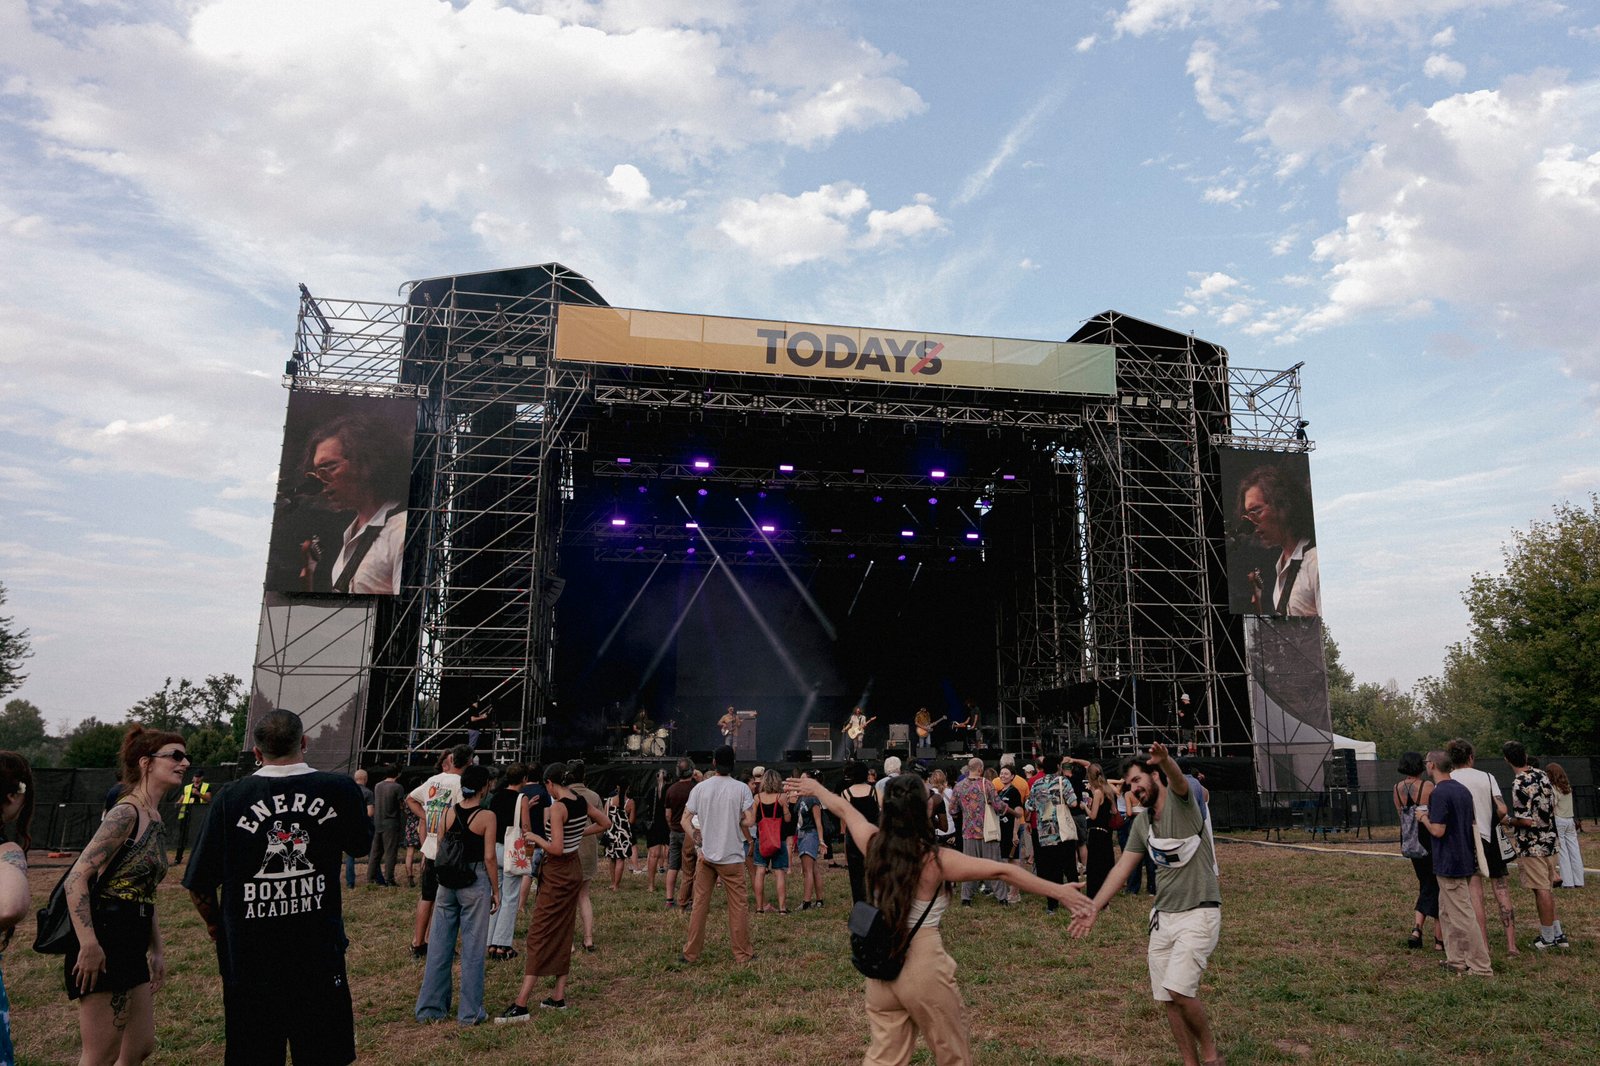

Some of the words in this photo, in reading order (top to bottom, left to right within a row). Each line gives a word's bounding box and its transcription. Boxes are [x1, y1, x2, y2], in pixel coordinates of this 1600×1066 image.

[236, 793, 338, 834] ENERGY
[243, 874, 326, 902] BOXING
[245, 894, 323, 919] ACADEMY
